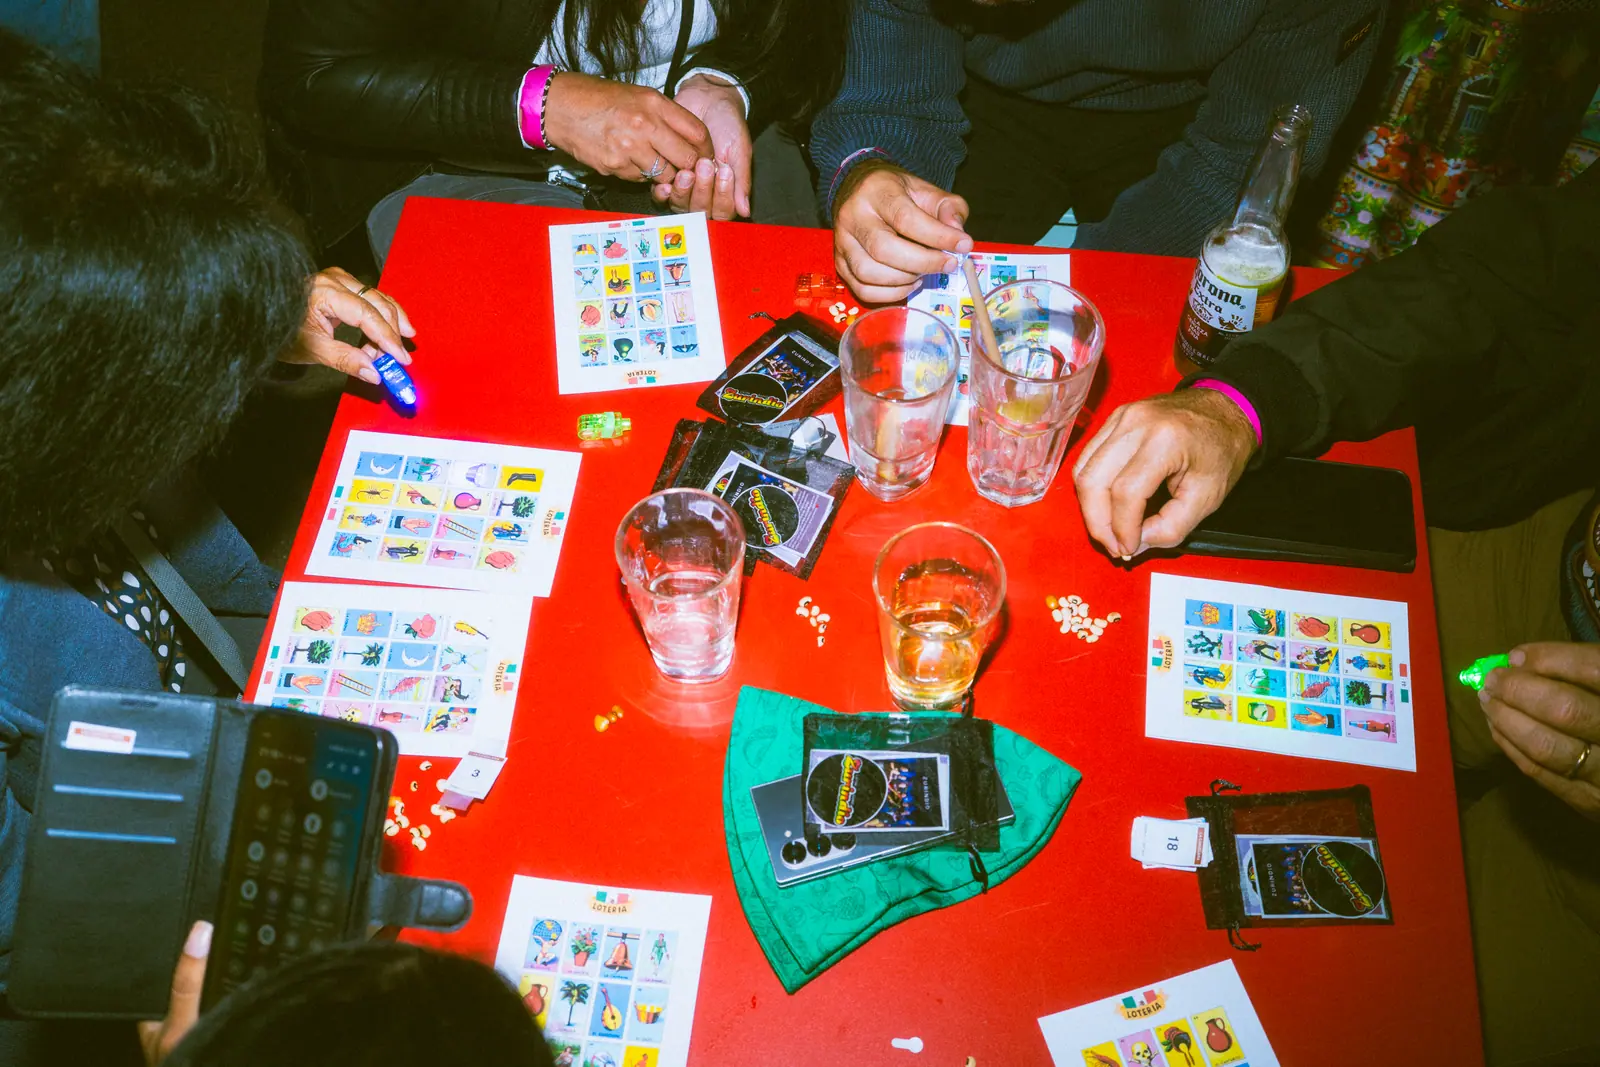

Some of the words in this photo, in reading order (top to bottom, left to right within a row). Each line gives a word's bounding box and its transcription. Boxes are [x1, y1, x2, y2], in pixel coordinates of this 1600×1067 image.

[1195, 280, 1223, 313] Extra
[791, 350, 815, 368] ZURINDIO
[627, 370, 657, 378] LOTERIA
[721, 387, 785, 409] Zurindio
[543, 510, 555, 536] LOTERIA
[749, 488, 782, 545] Zurindio
[1164, 640, 1172, 669] LOTERIA
[495, 662, 506, 691] LOTERIA
[471, 768, 481, 778] 3
[834, 753, 863, 826] Zurindio
[924, 774, 932, 811] ZURINDIO
[1167, 836, 1179, 851] 18
[1266, 863, 1278, 897] ZURINDIO
[1316, 844, 1374, 912] Zurindio
[592, 903, 628, 914] LOTERIA
[1126, 1003, 1162, 1019] LOTERIA
